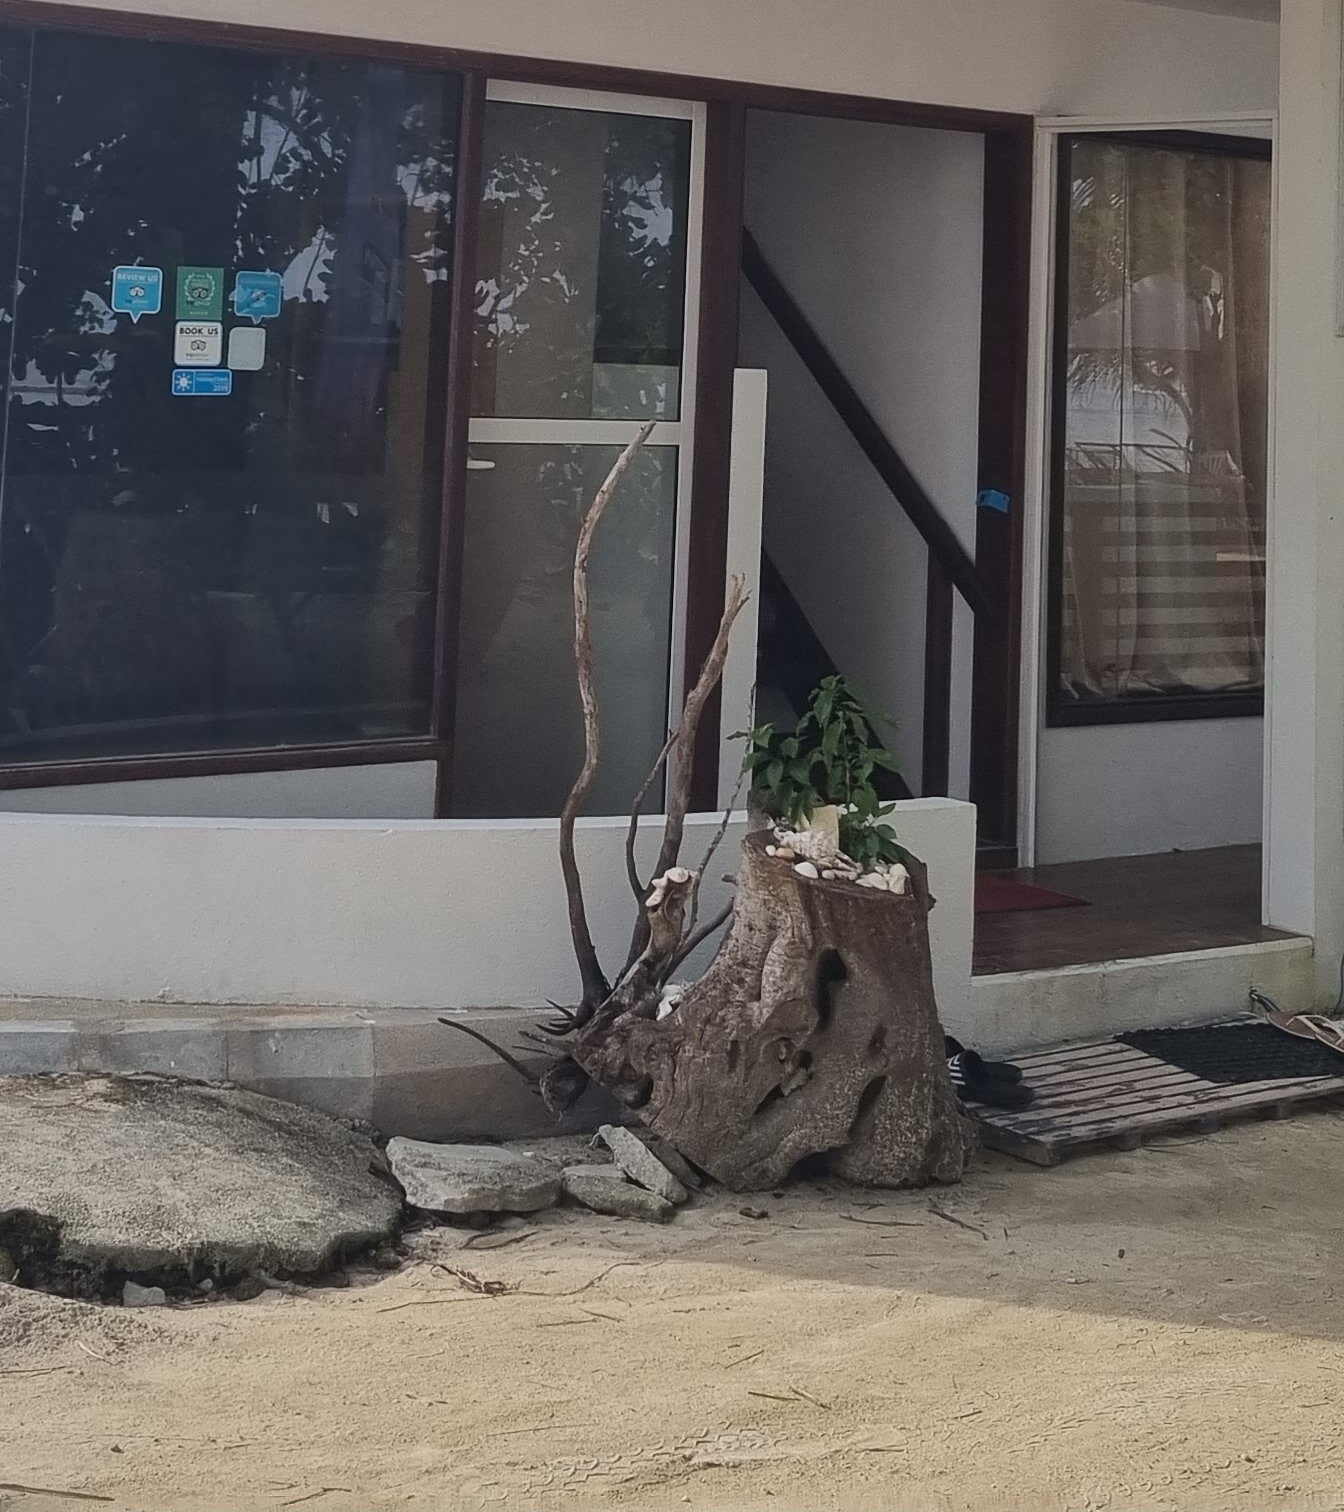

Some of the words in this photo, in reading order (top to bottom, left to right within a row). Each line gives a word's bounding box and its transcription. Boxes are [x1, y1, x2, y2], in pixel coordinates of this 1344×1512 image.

[117, 273, 146, 281] REVIEW
[147, 274, 159, 282] US
[179, 327, 204, 335] BOOK
